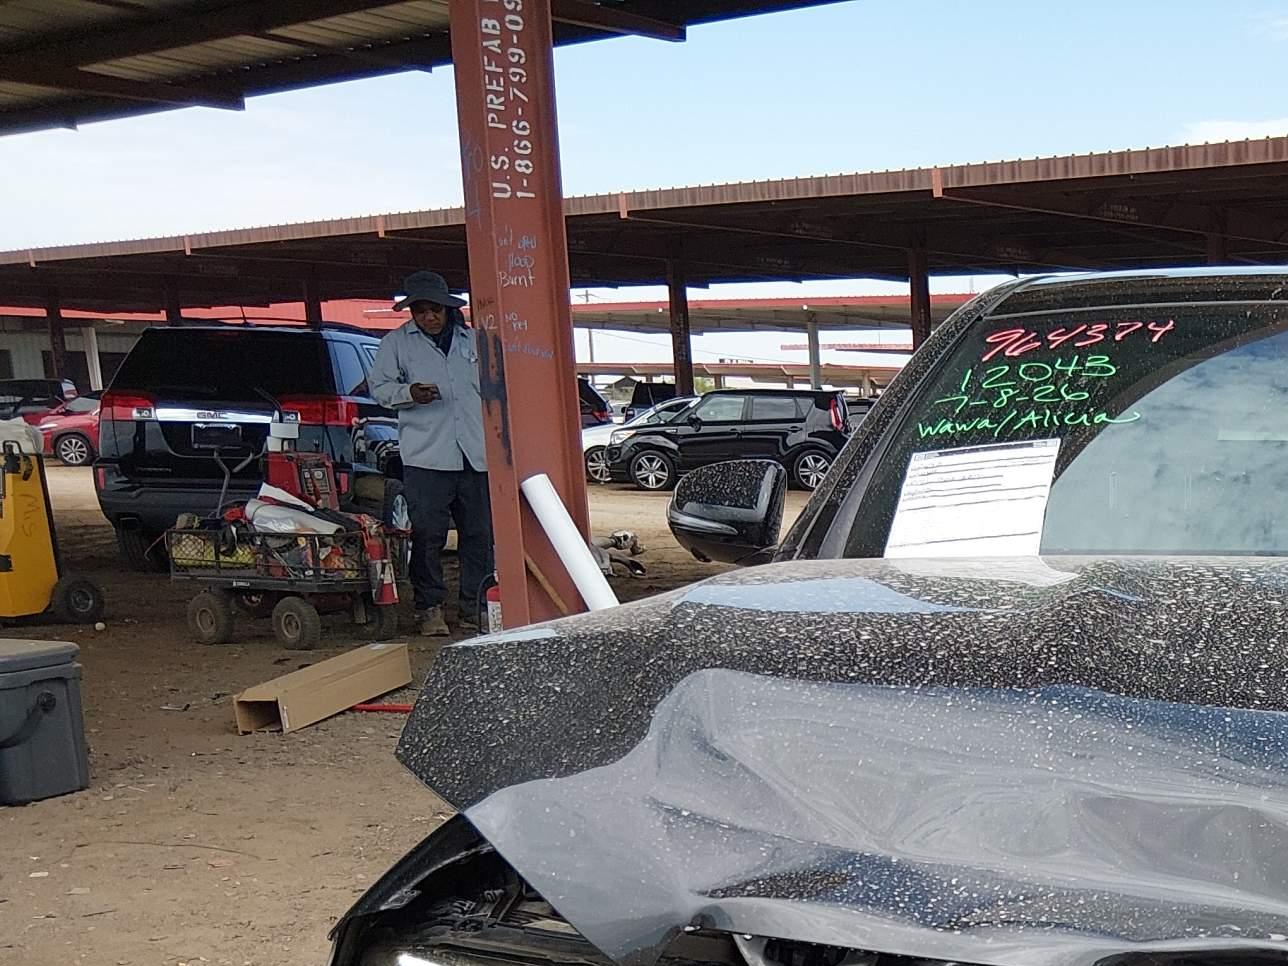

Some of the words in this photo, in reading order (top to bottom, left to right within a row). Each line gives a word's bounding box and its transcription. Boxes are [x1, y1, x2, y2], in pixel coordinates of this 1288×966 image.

[481, 18, 507, 129] PREFAB
[504, 0, 536, 199] 1-866-799-09
[491, 147, 512, 199] U.S.
[982, 319, 1174, 362] 964374
[935, 384, 1089, 413] 7-8-26
